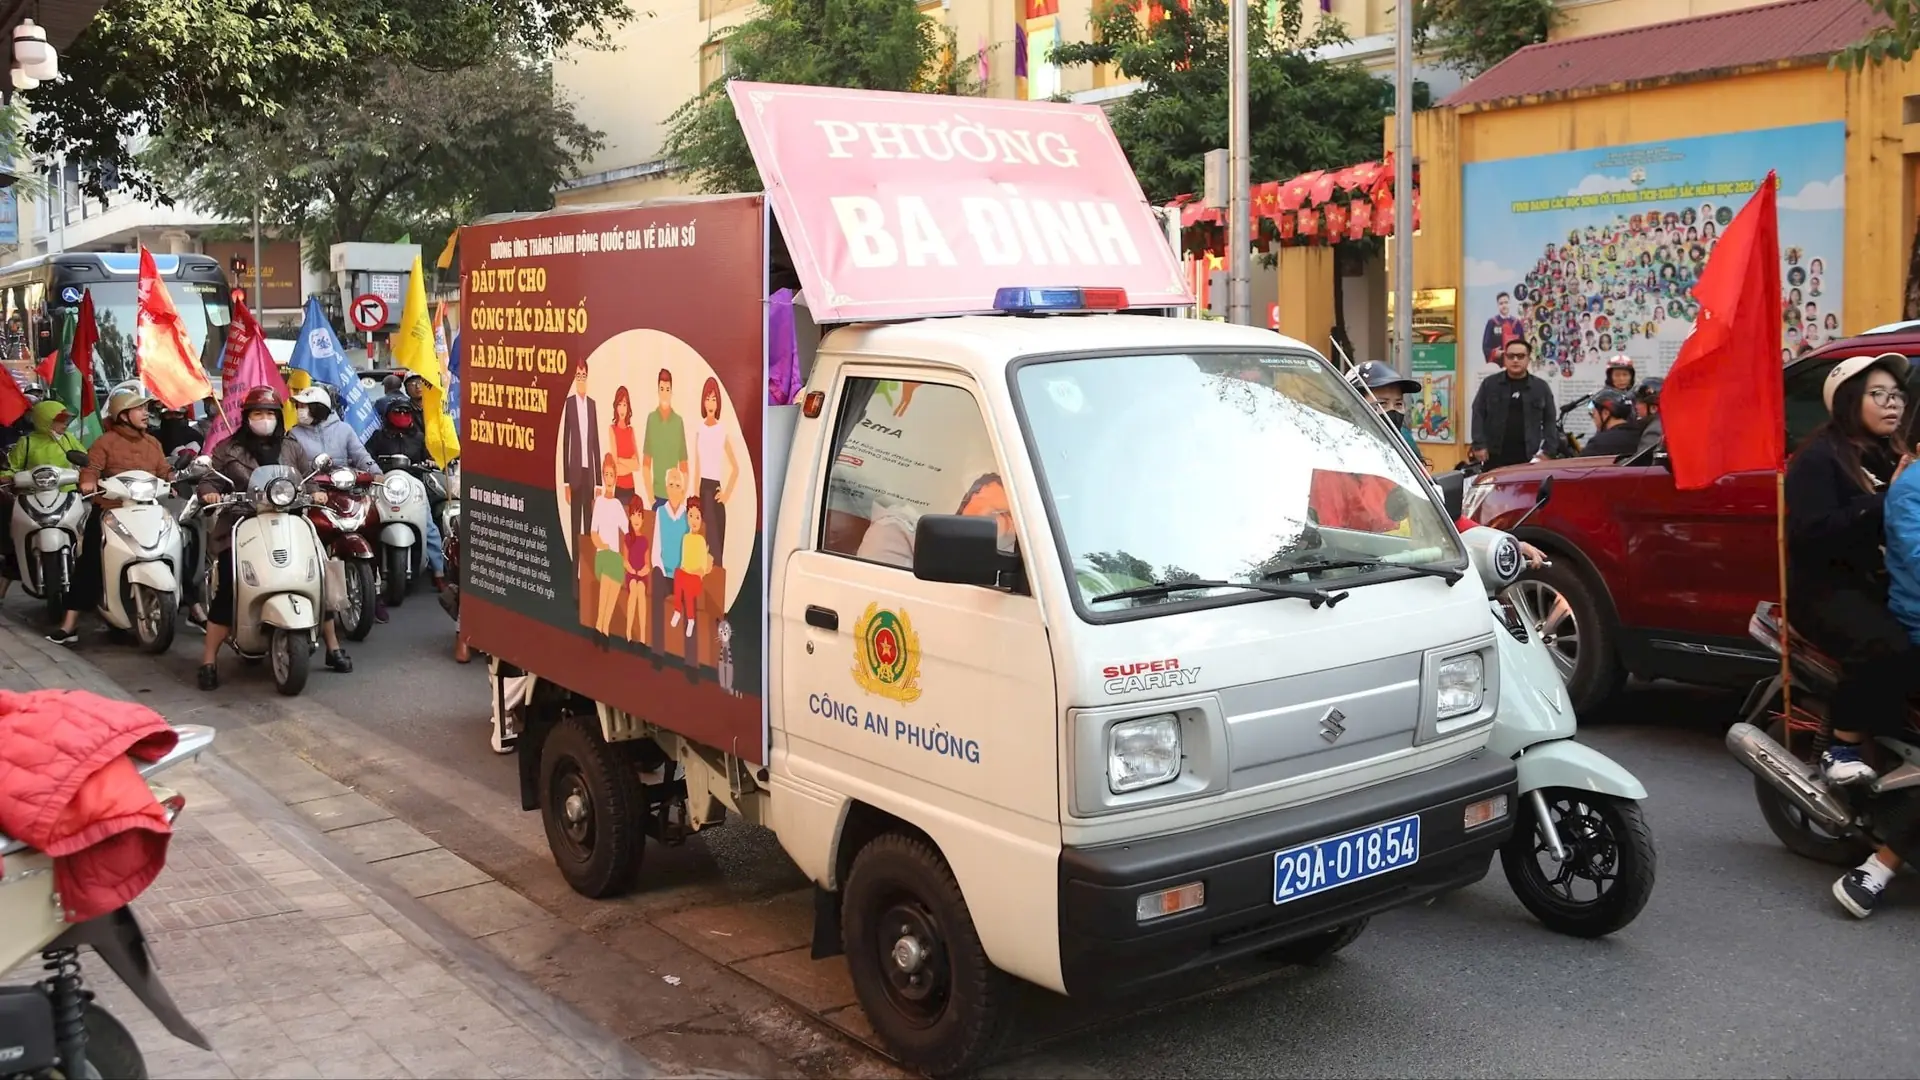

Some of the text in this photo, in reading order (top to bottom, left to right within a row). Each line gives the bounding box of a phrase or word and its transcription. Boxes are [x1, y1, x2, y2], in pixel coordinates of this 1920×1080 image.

[814, 113, 1081, 168] PHƯỜNG
[529, 234, 553, 256] THÁNG
[553, 231, 575, 254] HÀNH
[576, 229, 599, 257] ĐỘNG
[600, 224, 624, 252] QUỐC
[626, 229, 642, 250] GIA
[643, 221, 656, 249] VỀ
[658, 222, 679, 248] DÂN
[681, 218, 697, 247] SỐ
[829, 182, 1142, 268] BA ĐÌNH
[497, 265, 516, 293] TƯ
[518, 267, 547, 292] CHO
[471, 295, 588, 334] CÔNG TÁC DÂN SỐ
[470, 337, 486, 368] LÀ
[516, 345, 536, 372] TƯ
[537, 348, 567, 375] CHO
[470, 376, 504, 408] PHÁT
[506, 376, 549, 413] TRIỂN
[496, 418, 535, 452] VỮNG
[1103, 658, 1180, 678] SUPER
[1104, 667, 1201, 695] CARRY
[809, 692, 980, 764] CÔNG AN PHƯỜNG
[1278, 823, 1415, 898] 29A-018.54
